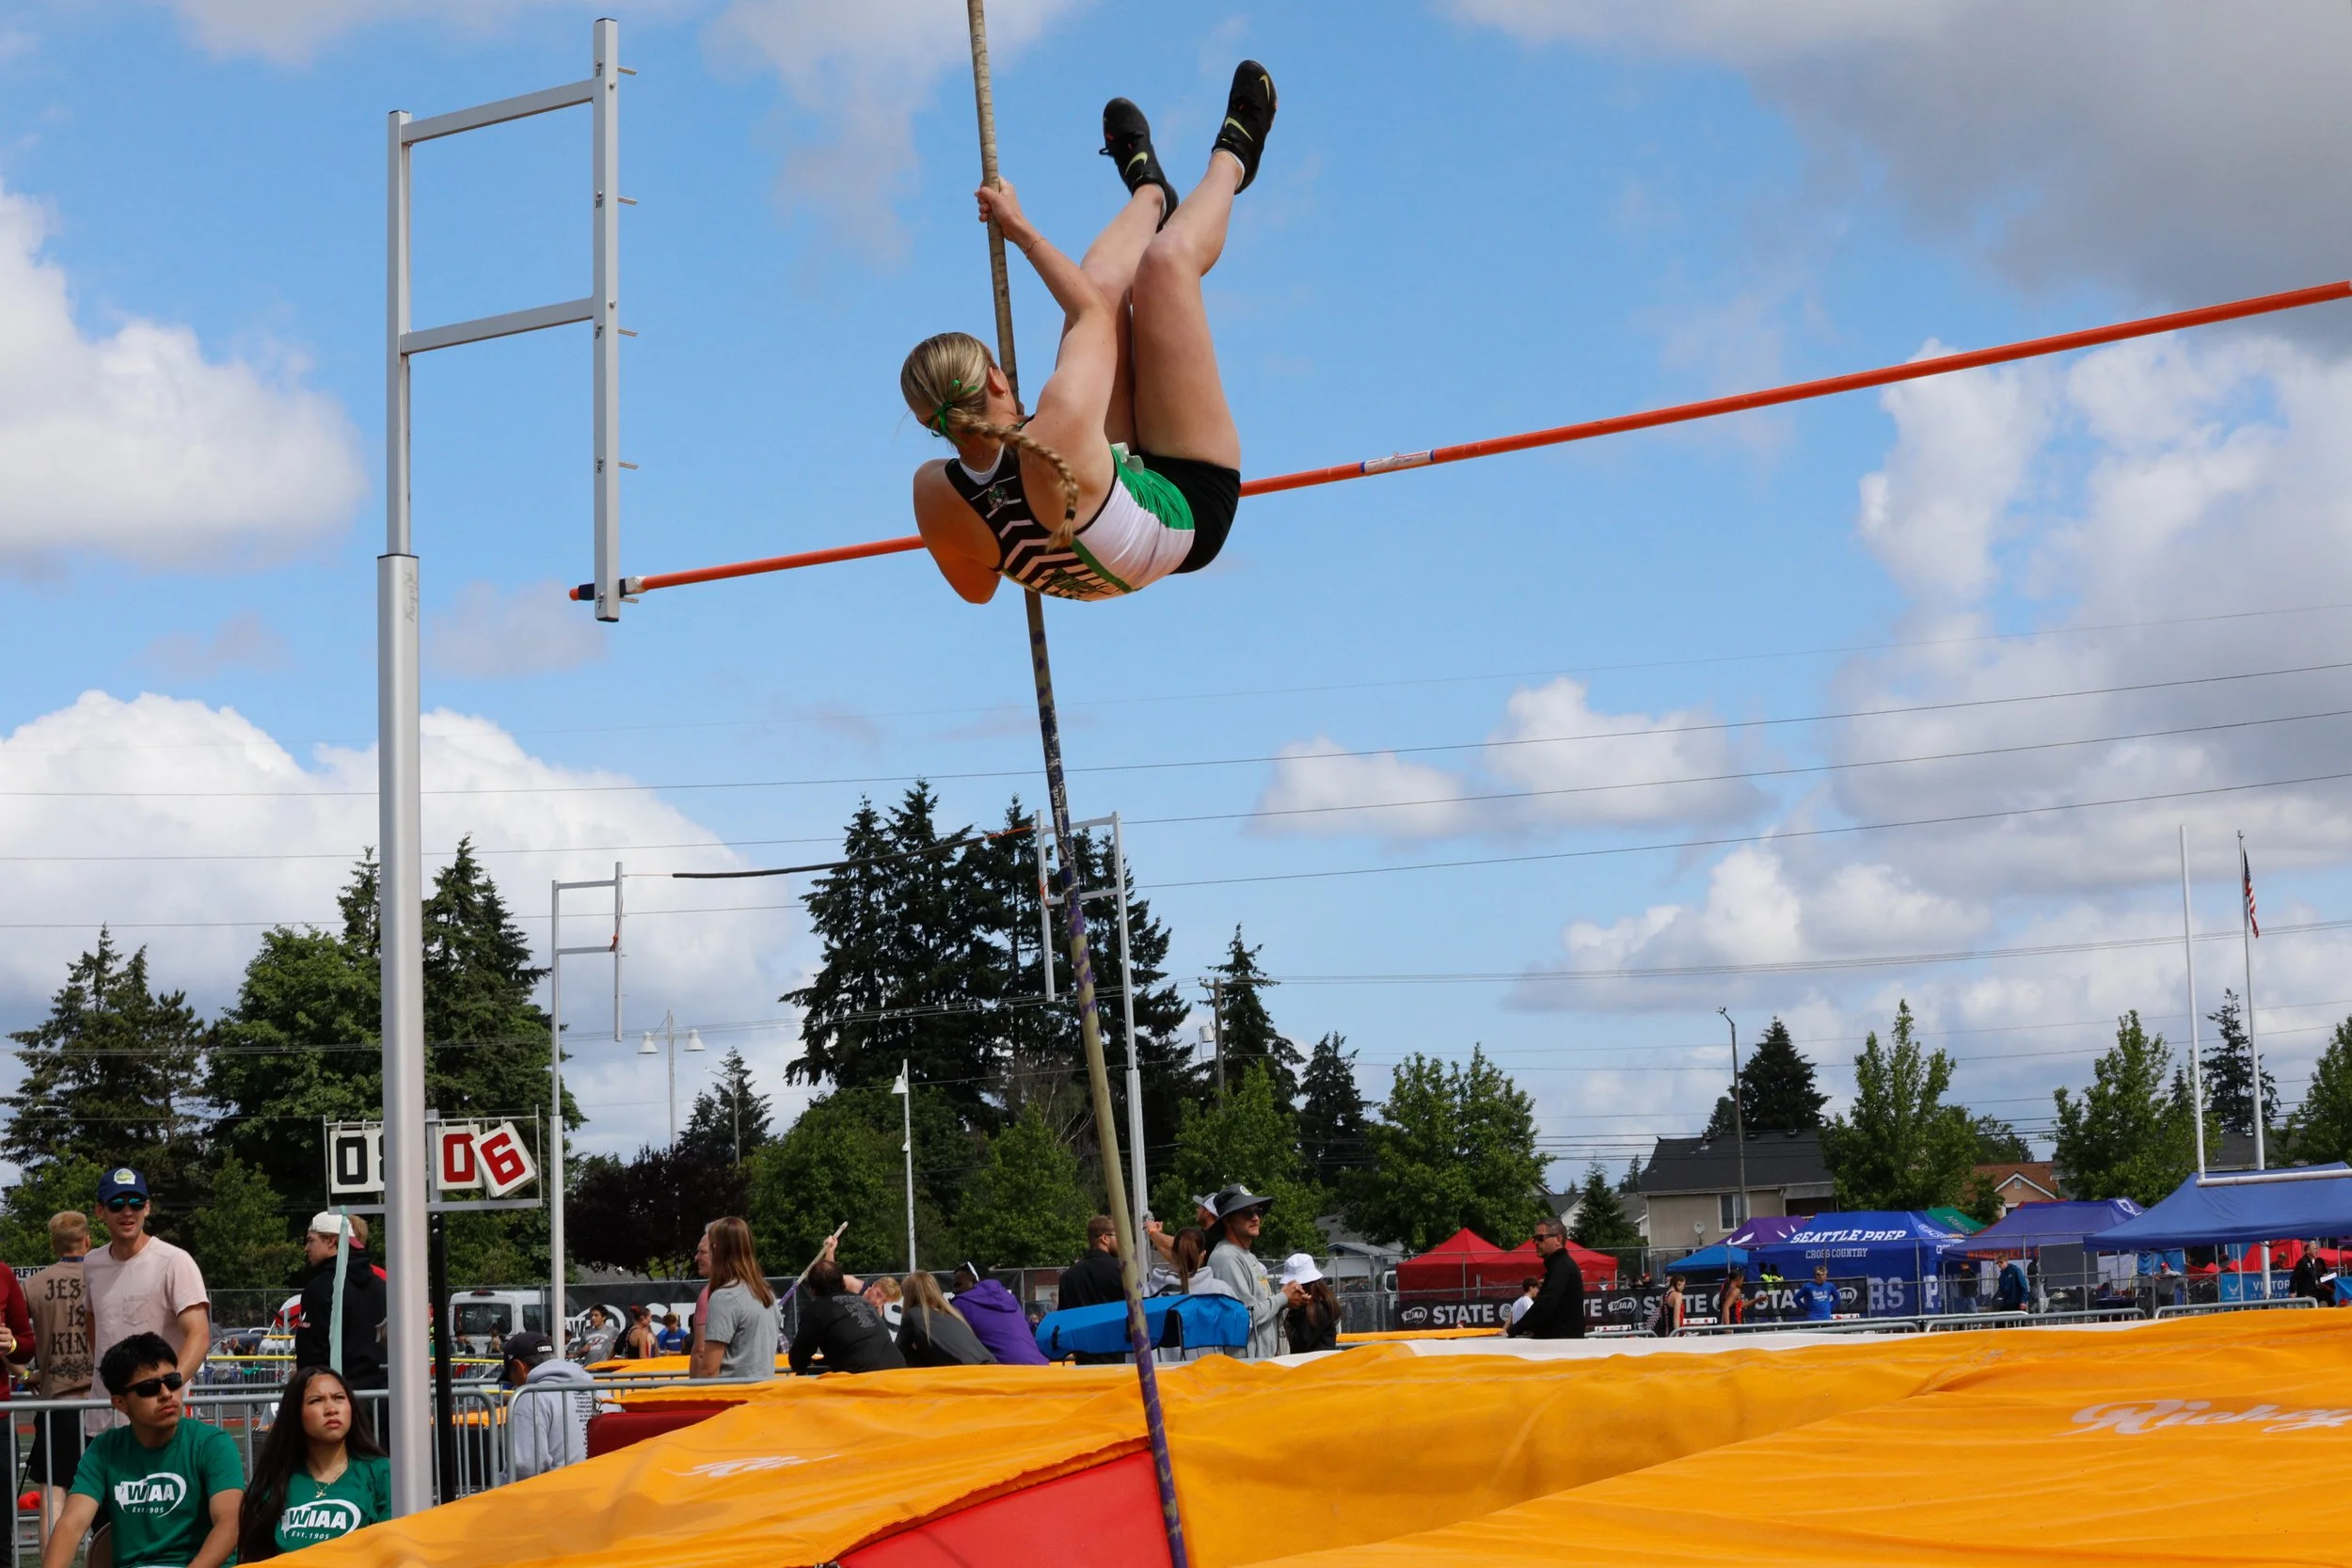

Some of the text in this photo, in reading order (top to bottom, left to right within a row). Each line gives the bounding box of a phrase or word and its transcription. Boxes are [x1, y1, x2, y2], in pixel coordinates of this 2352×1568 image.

[1789, 1229, 1863, 1243] SEATTLE
[1861, 1229, 1907, 1242] PREP
[1805, 1247, 1868, 1259] CROSS COUNTRY
[45, 1278, 86, 1301] JES
[1433, 1304, 1494, 1325] STATE
[51, 1332, 88, 1354] KIN
[290, 1509, 347, 1529] WIAA
